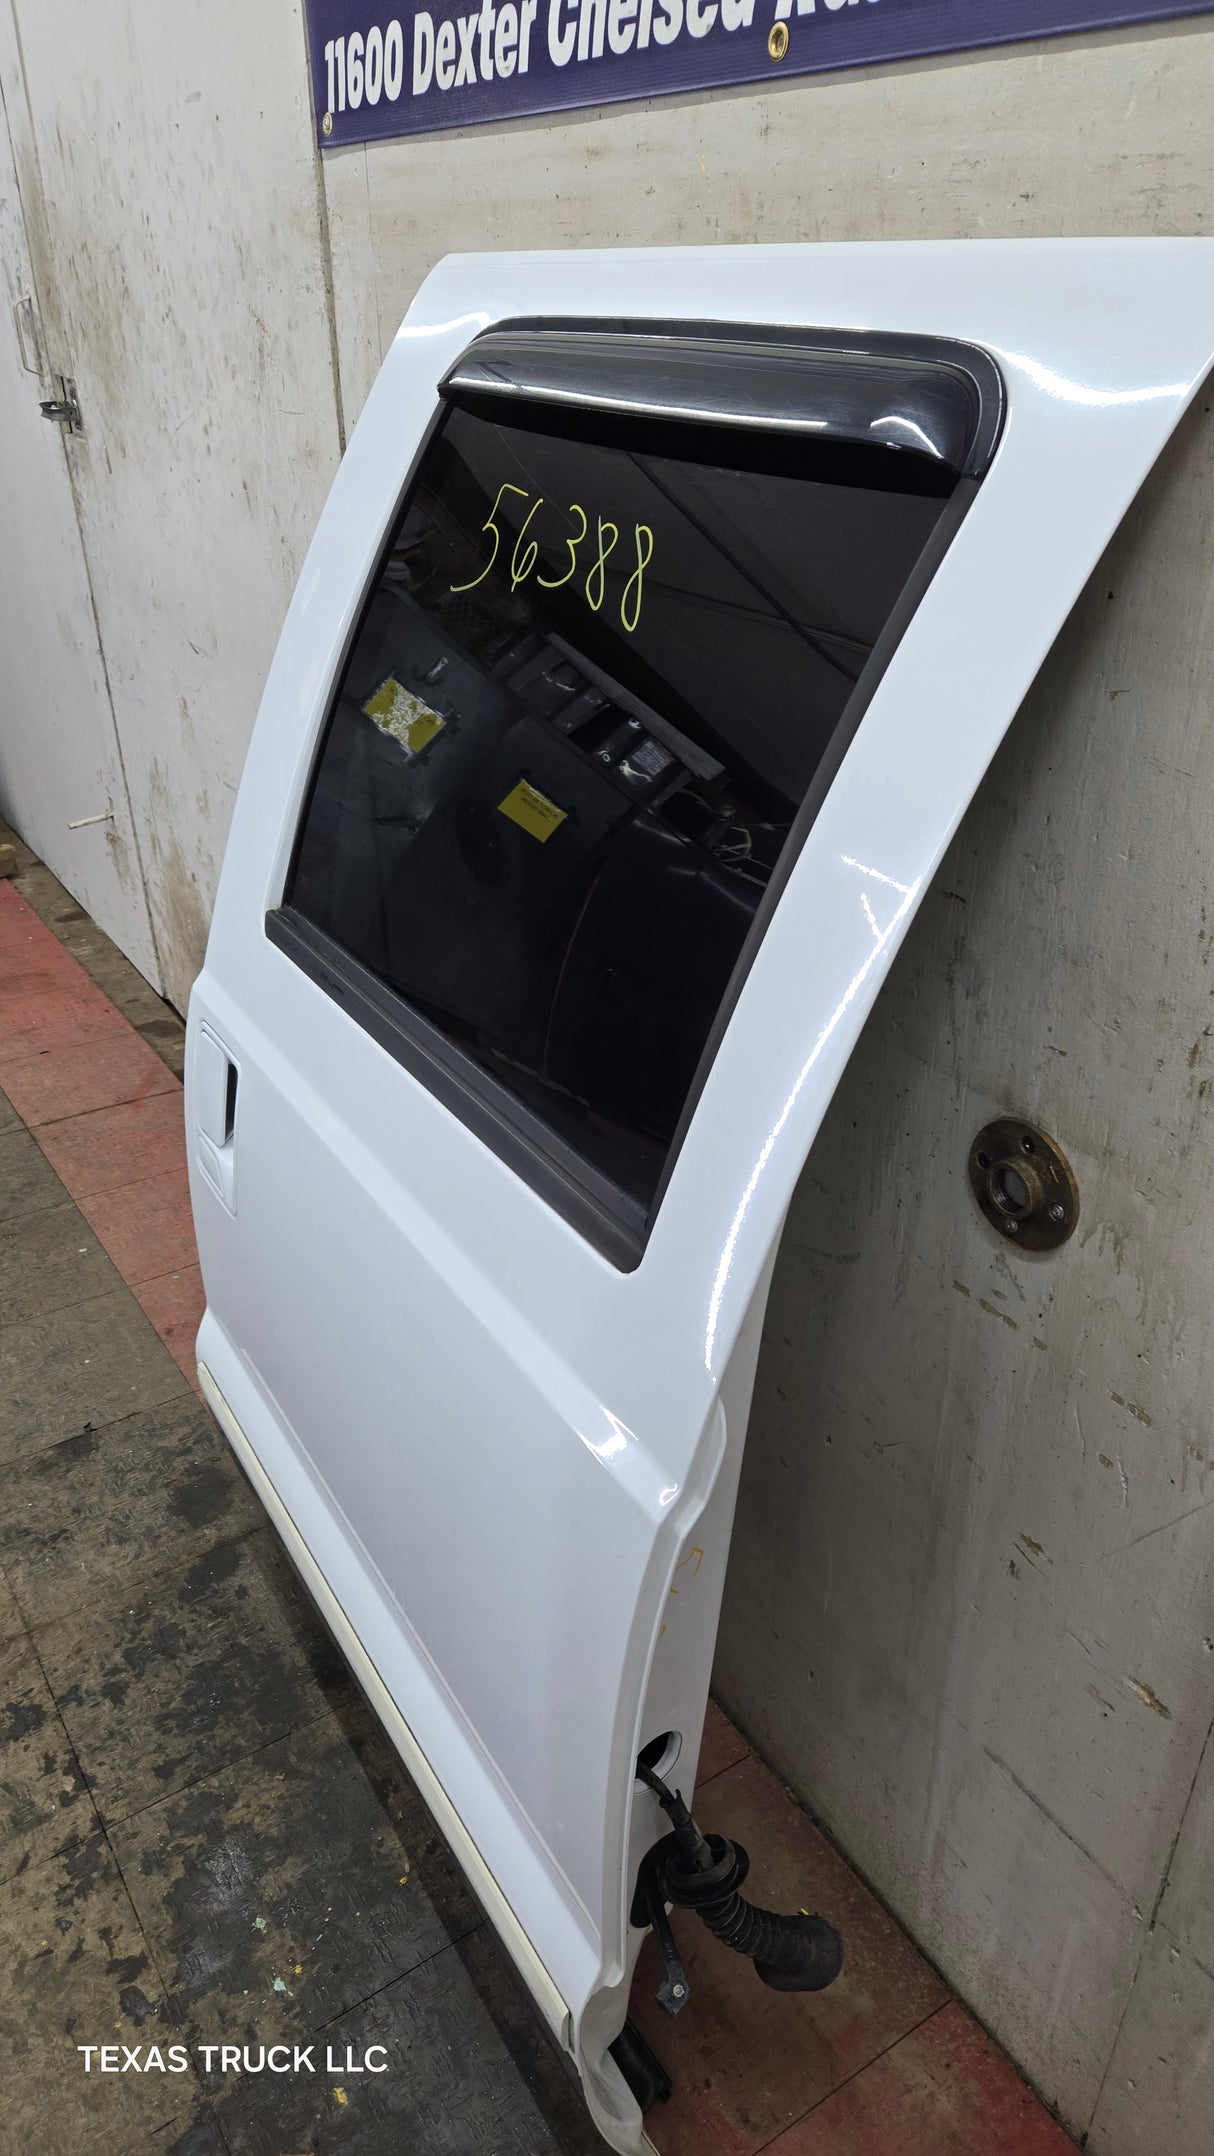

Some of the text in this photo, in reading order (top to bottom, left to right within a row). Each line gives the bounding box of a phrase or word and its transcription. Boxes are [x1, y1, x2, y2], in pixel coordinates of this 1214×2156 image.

[324, 19, 404, 113] 11600
[412, 0, 538, 96] Dexter
[450, 483, 654, 632] 56388
